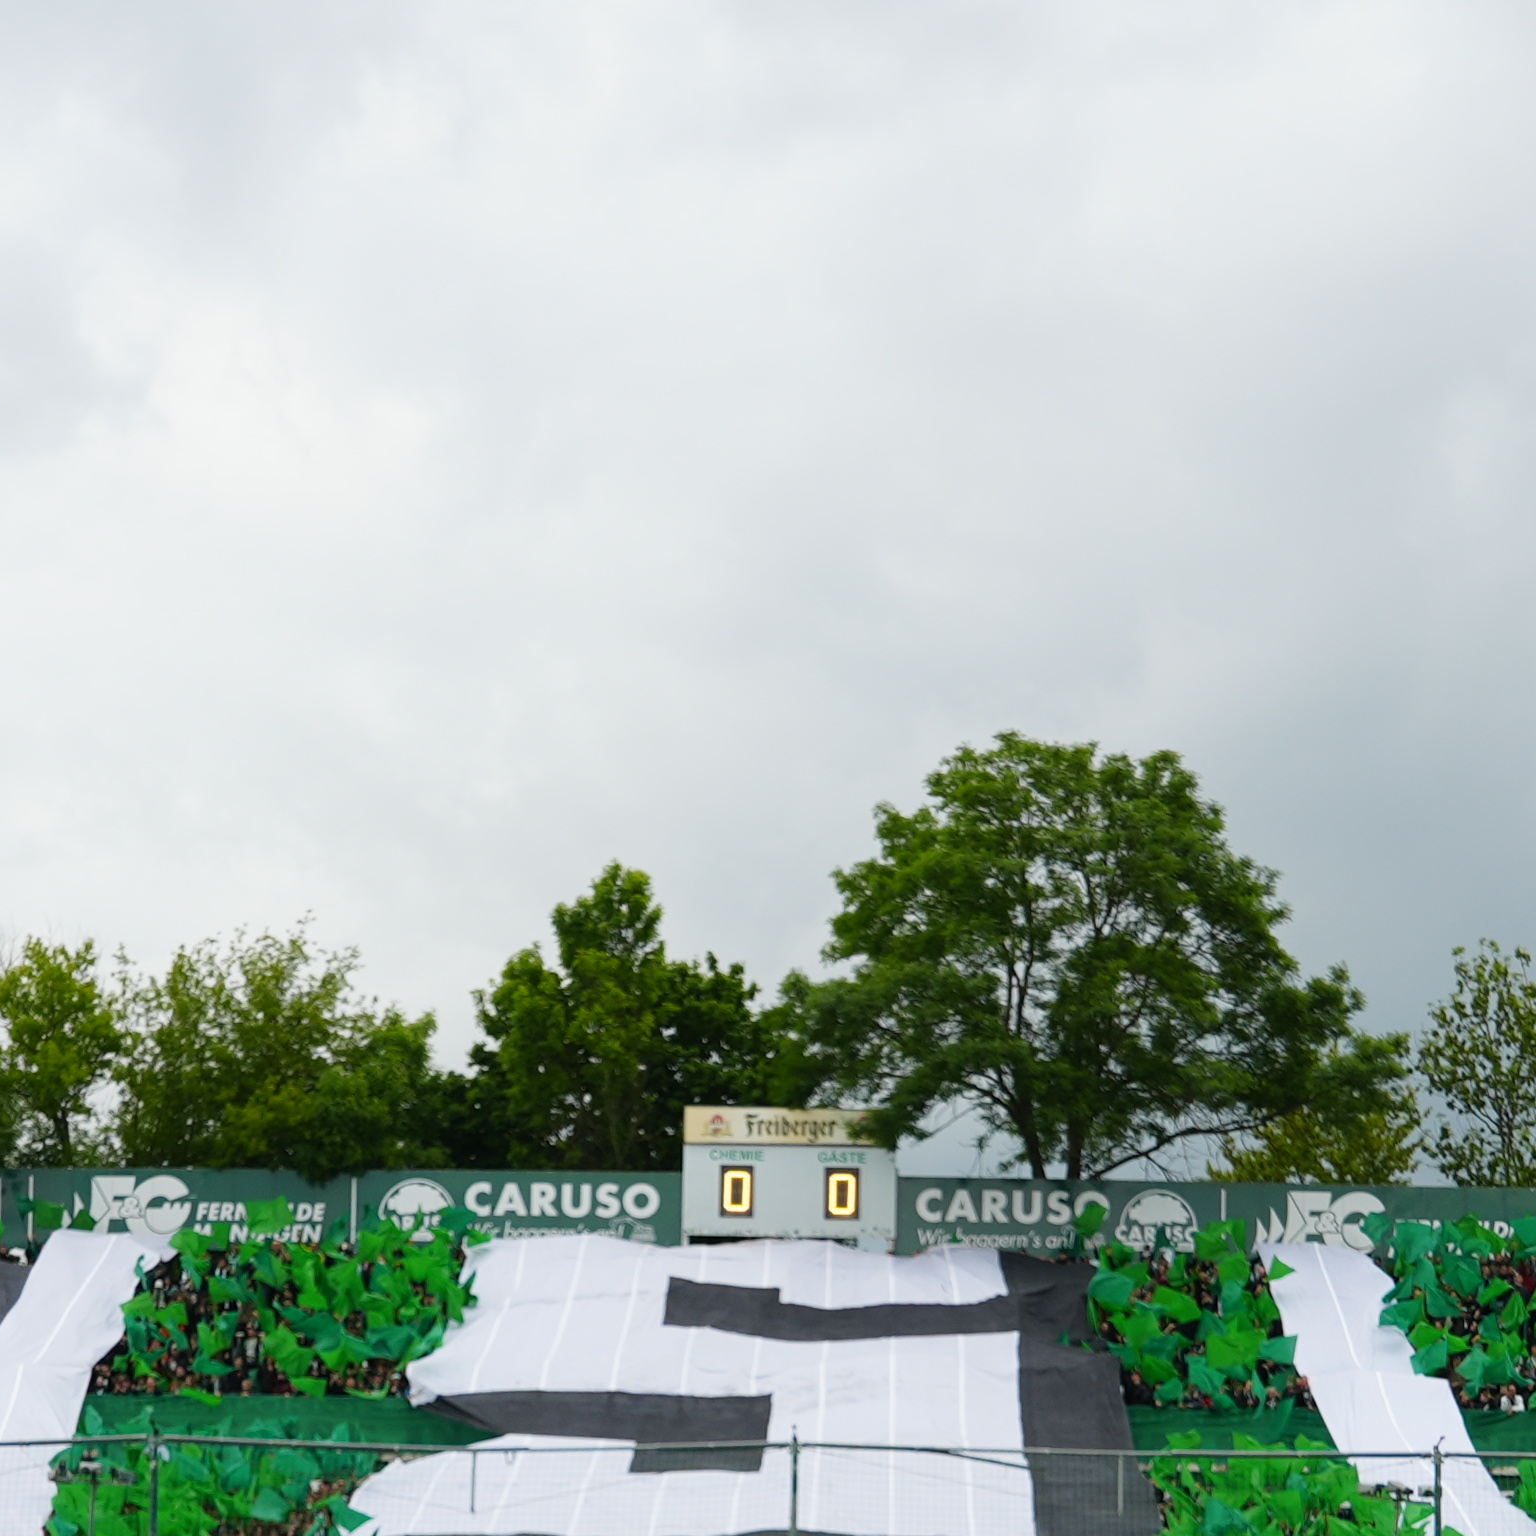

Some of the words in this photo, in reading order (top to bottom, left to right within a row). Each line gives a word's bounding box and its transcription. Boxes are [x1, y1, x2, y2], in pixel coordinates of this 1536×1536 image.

[745, 1113, 838, 1143] Freiberger
[709, 1149, 765, 1162] CHEMIE
[465, 1181, 661, 1219] CARUSO
[722, 1169, 752, 1213] 0
[828, 1172, 857, 1216] 0
